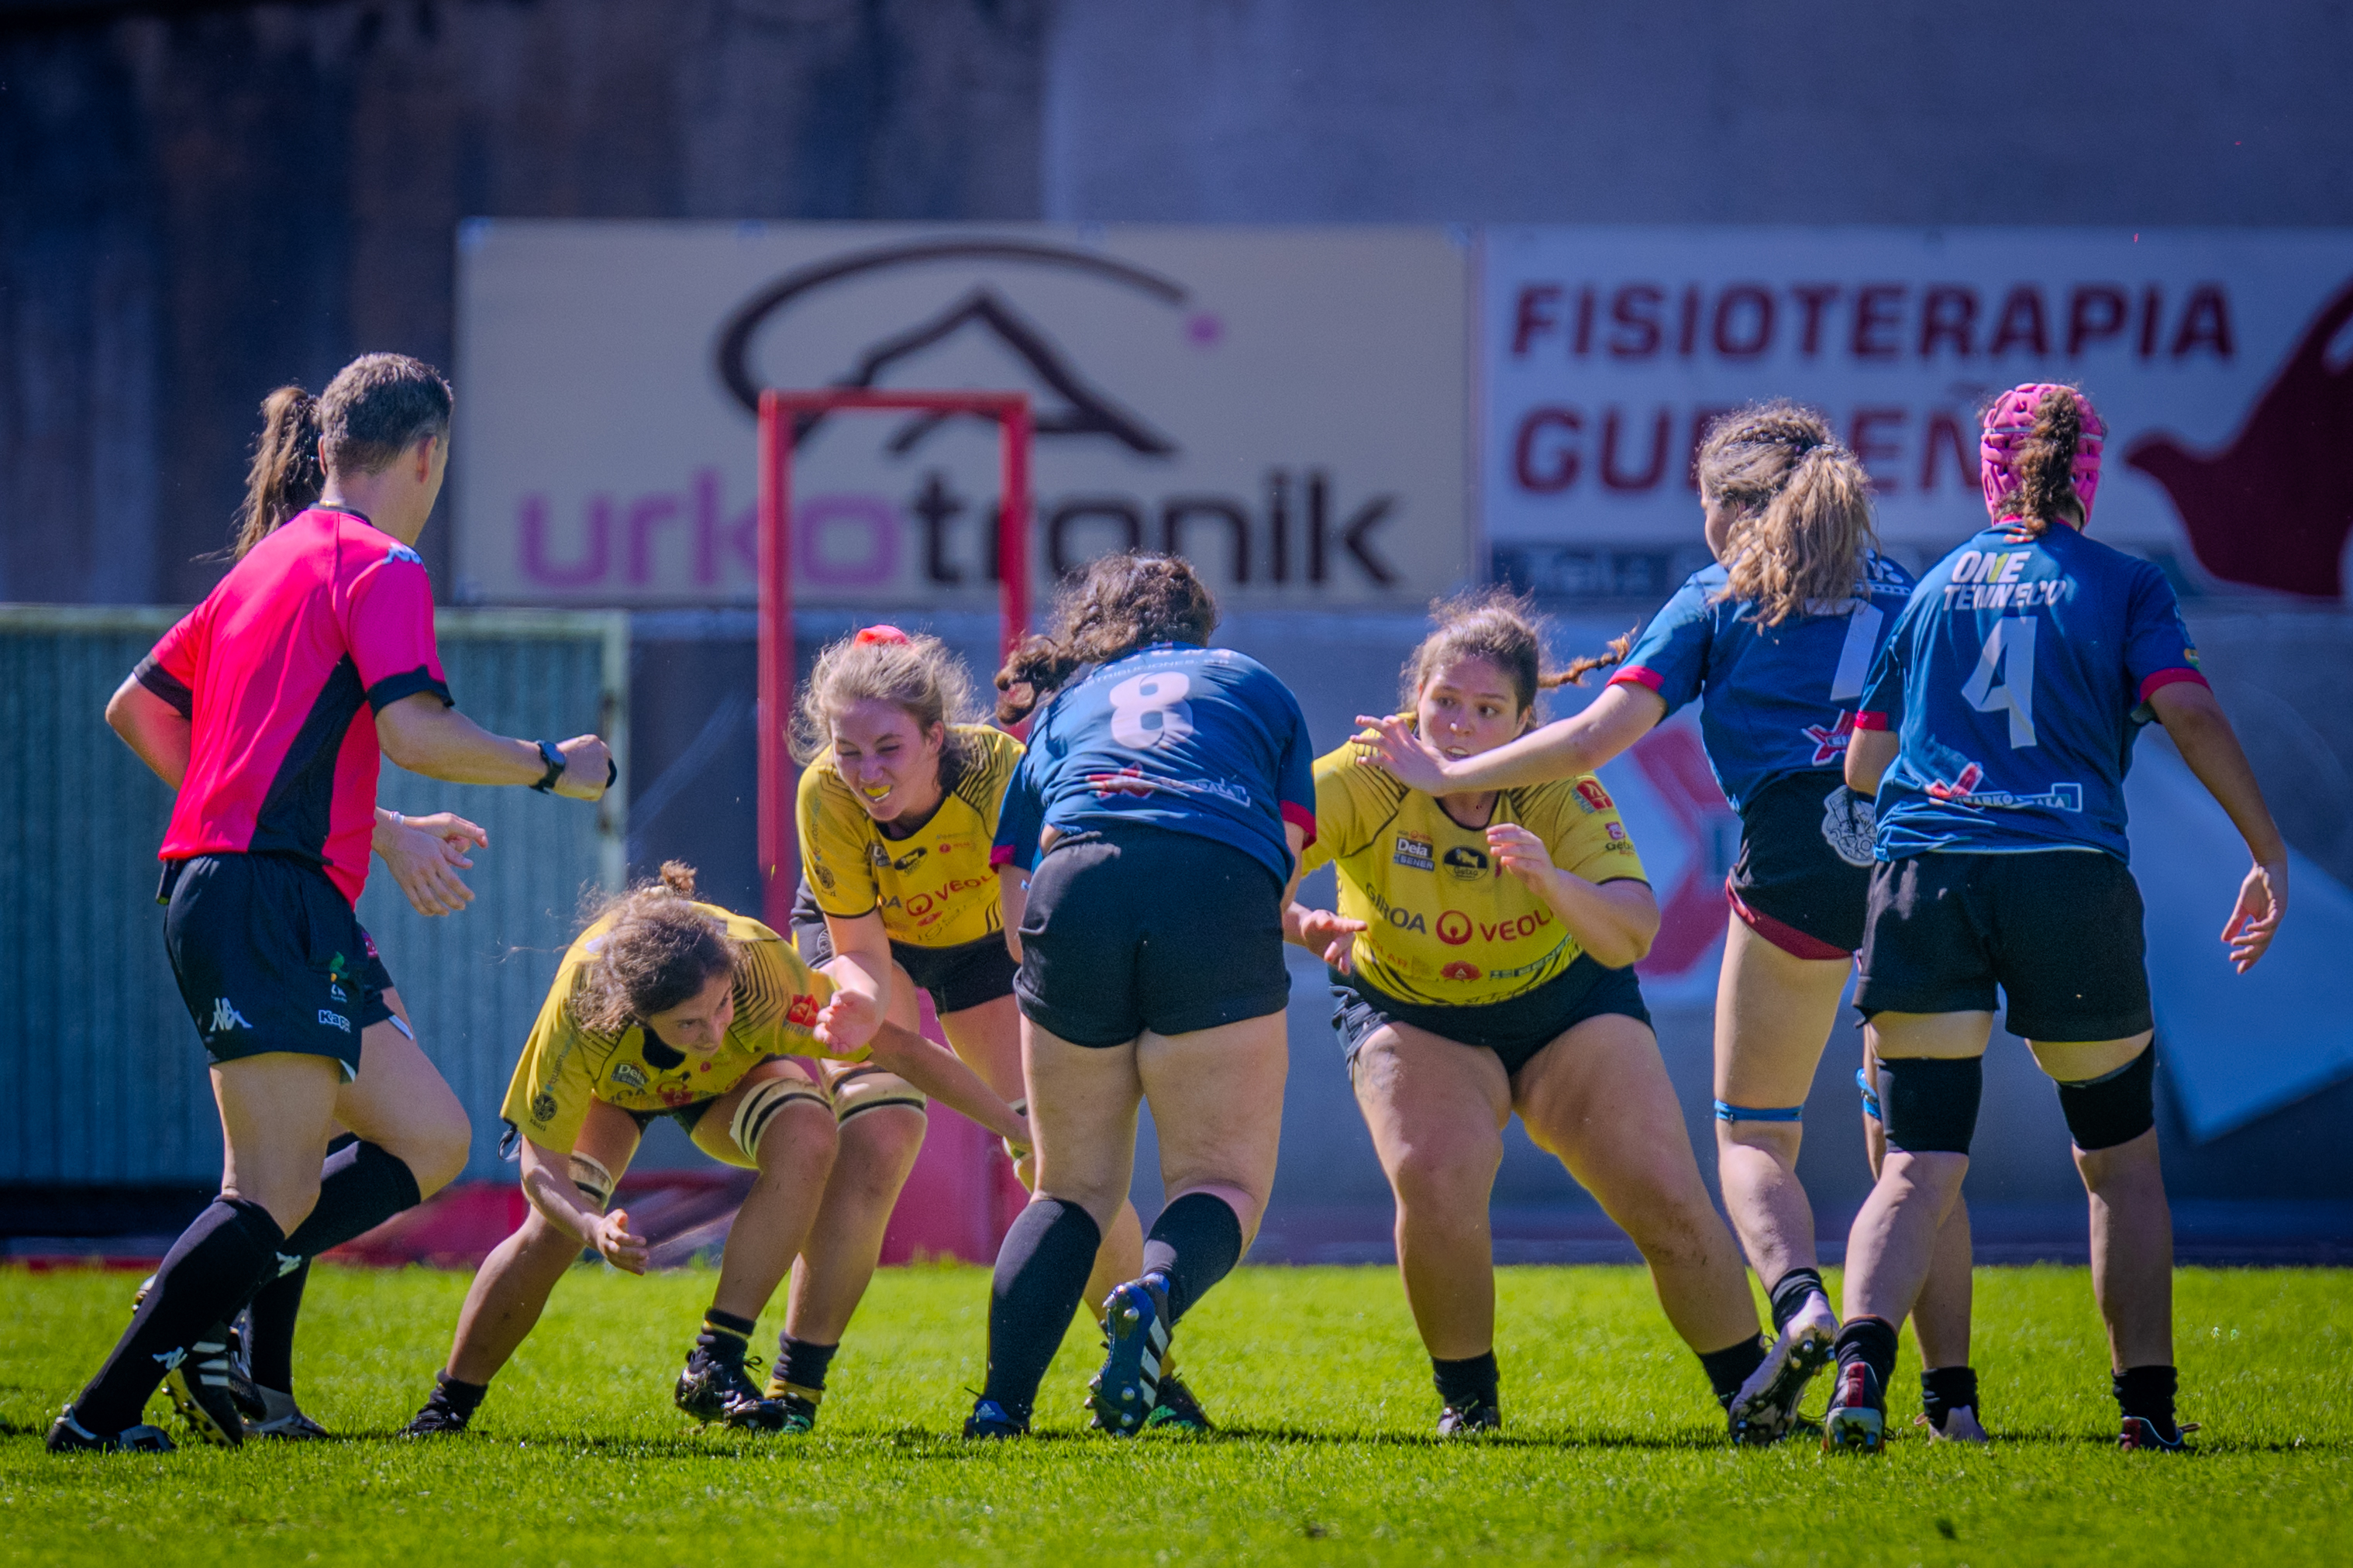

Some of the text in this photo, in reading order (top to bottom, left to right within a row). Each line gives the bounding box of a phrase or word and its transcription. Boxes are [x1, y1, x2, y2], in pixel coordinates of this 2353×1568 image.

[1512, 284, 2235, 358] FISIOTERAPIA
[1943, 579, 2067, 611] TENNECO
[1962, 615, 2038, 750] 4
[1110, 671, 1194, 749] 8
[1397, 838, 1428, 856] Deia
[1400, 855, 1434, 870] SENER
[935, 874, 998, 901] VEOL
[1366, 882, 1427, 935] GIROA
[1479, 908, 1554, 943] VEOL
